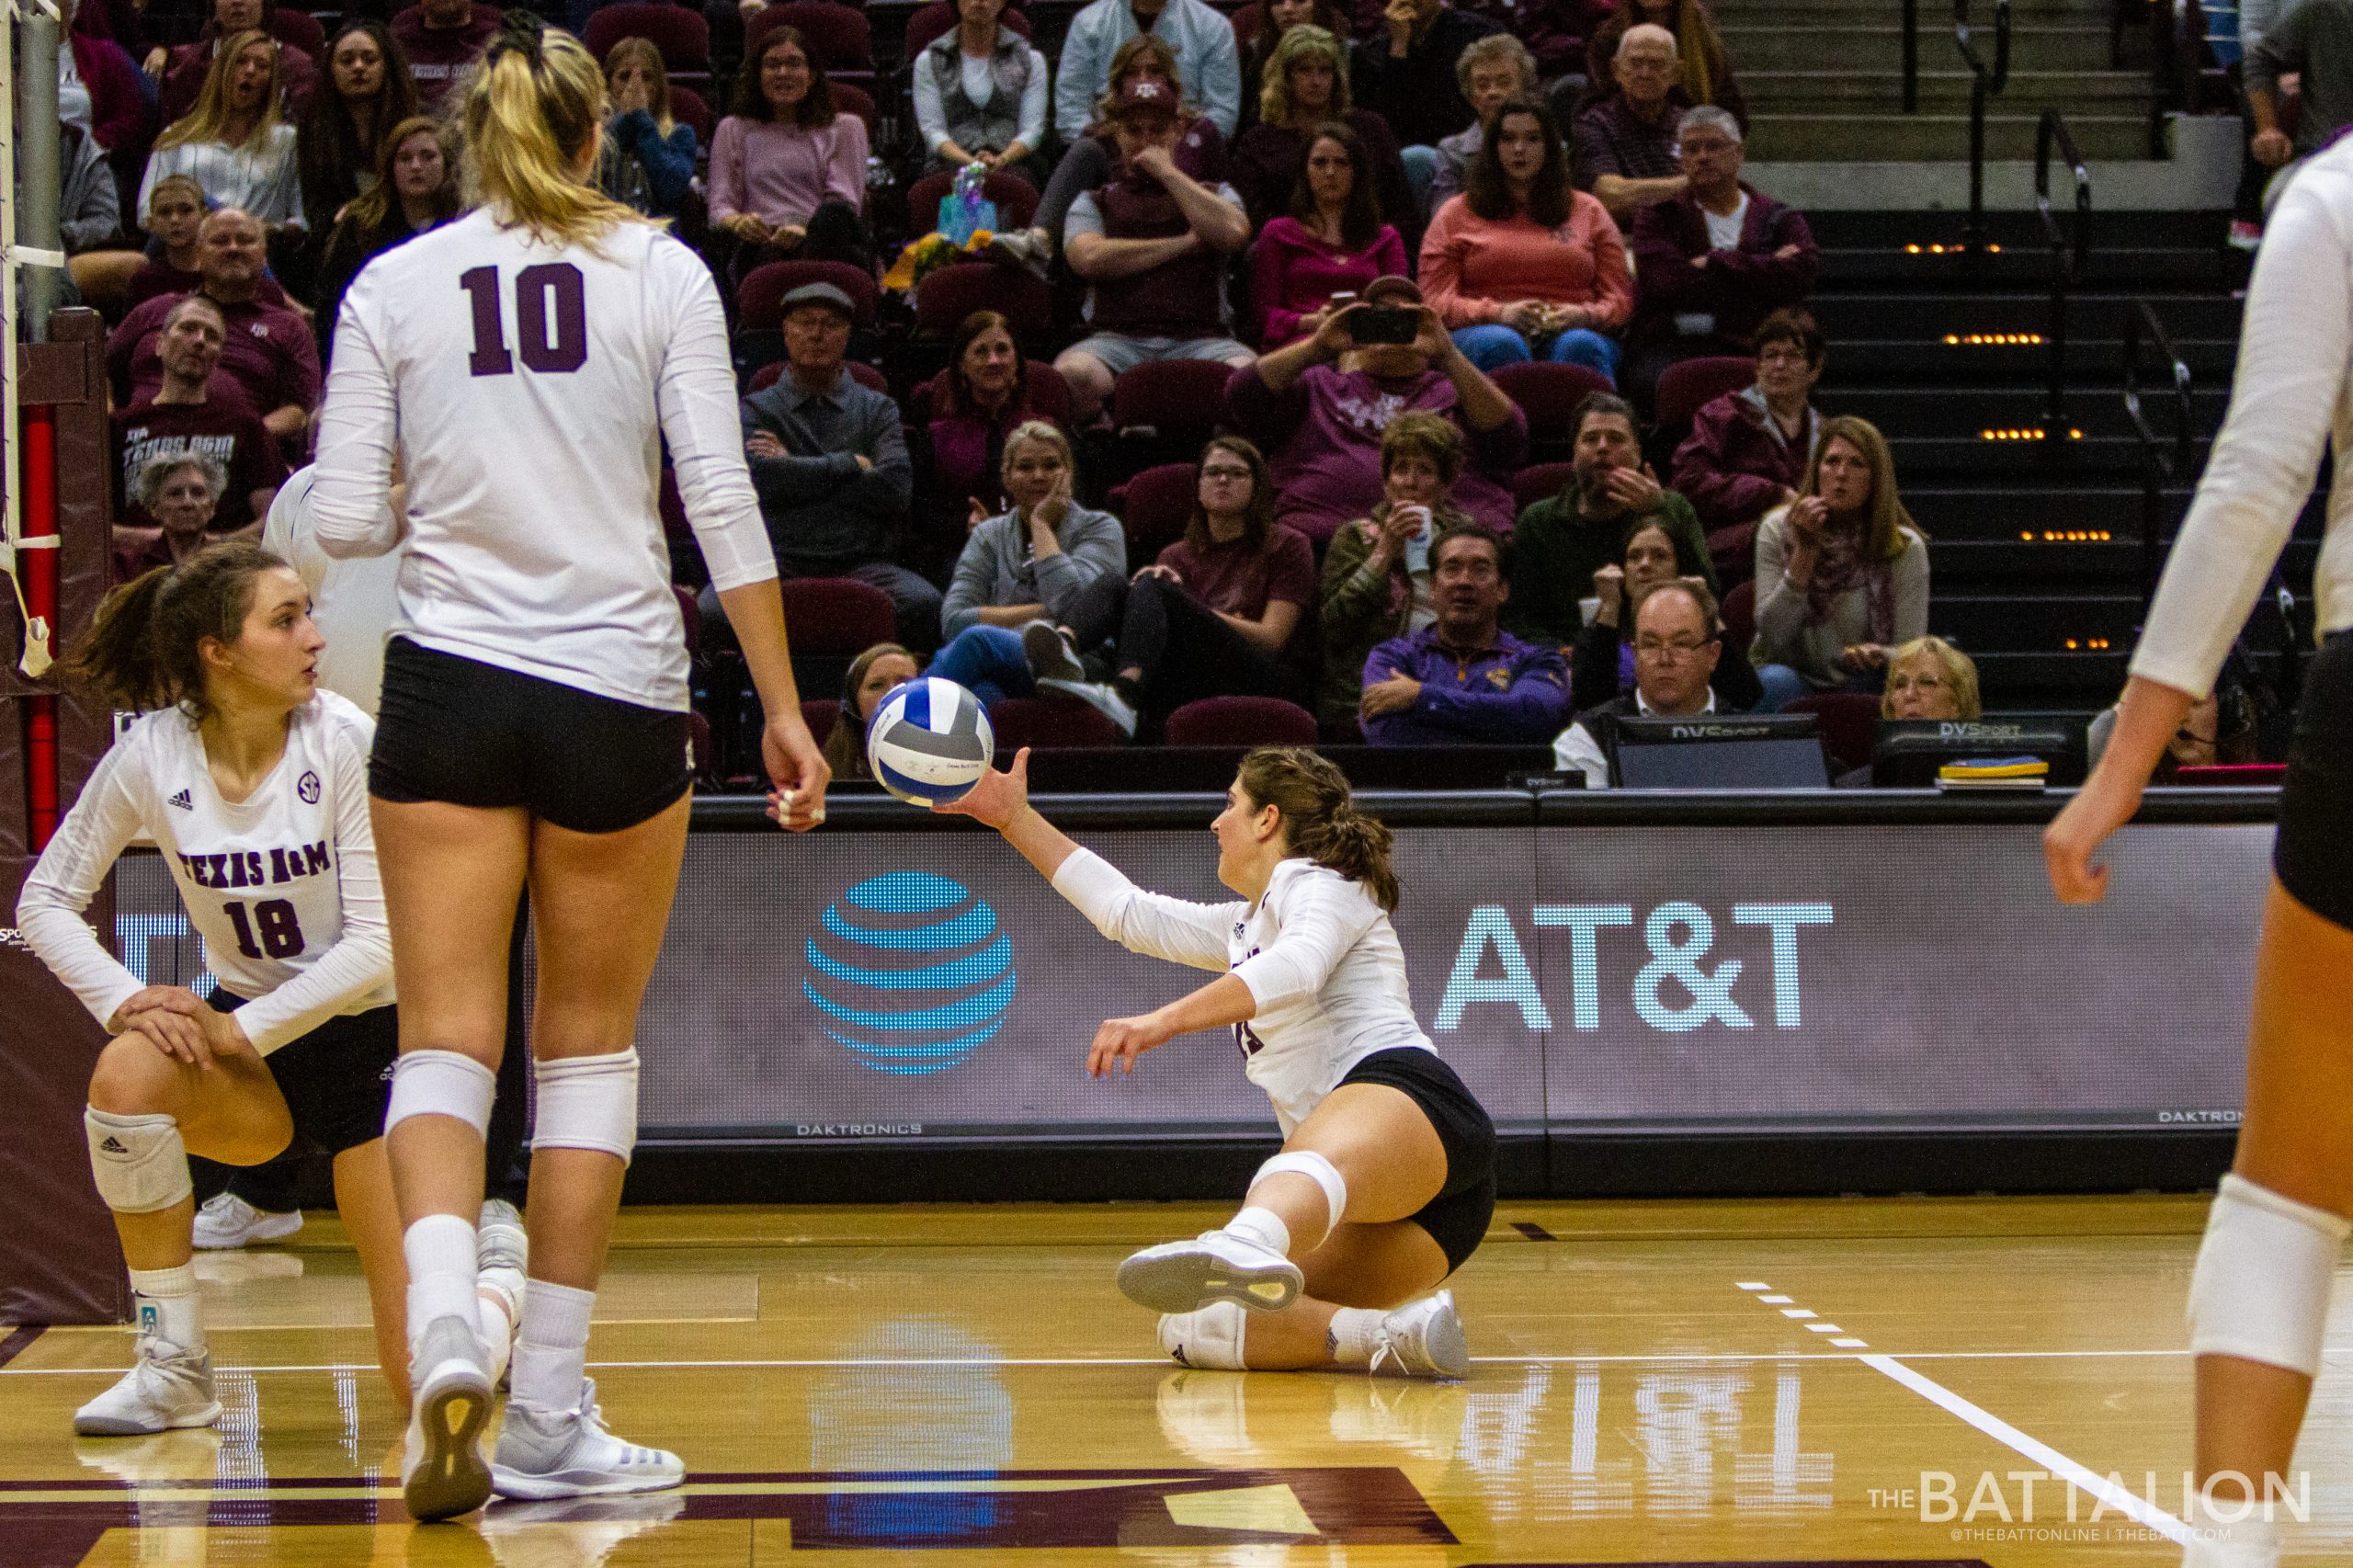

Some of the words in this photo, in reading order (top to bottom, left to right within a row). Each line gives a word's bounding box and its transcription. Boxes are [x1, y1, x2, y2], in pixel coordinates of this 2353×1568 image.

[460, 262, 586, 376] 10
[269, 840, 331, 884] A&M
[222, 899, 305, 960] 18
[1433, 900, 1835, 1032] AT&T
[797, 1123, 922, 1136] DAKTRONICS
[2158, 1110, 2245, 1122] DAKTRON
